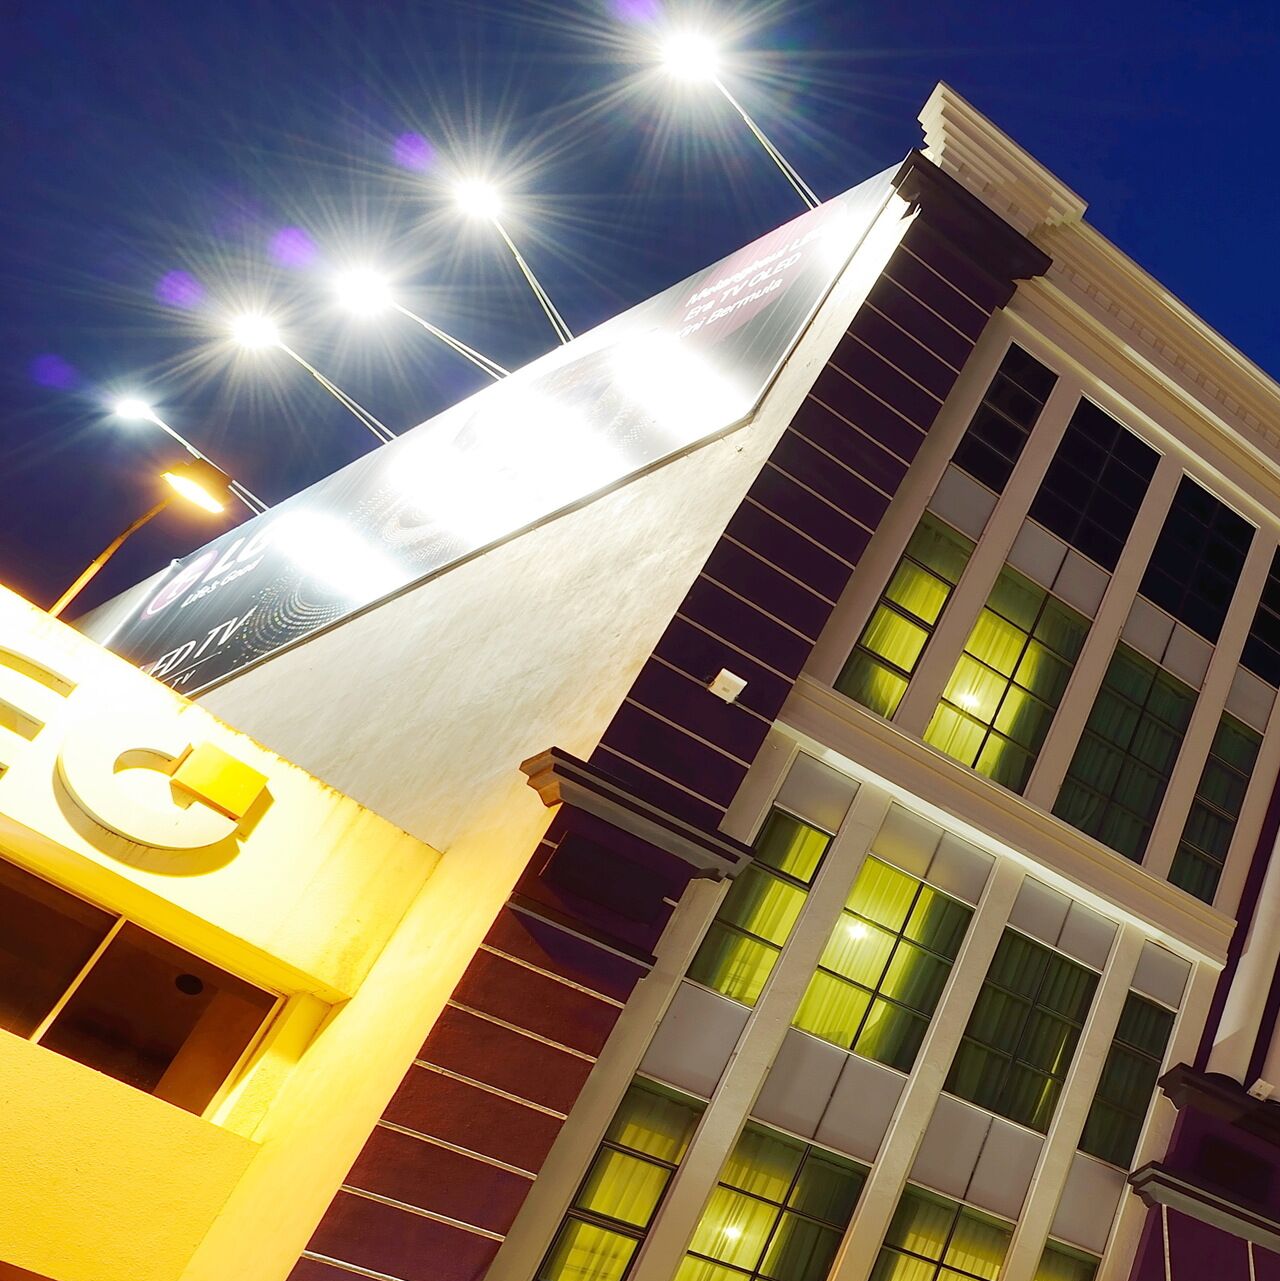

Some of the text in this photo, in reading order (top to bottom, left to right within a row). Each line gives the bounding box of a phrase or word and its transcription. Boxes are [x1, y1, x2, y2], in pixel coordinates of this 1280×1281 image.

[705, 278, 784, 325] Bermula
[720, 281, 747, 303] TV
[747, 252, 802, 288] OLED
[138, 605, 259, 678] ED TV
